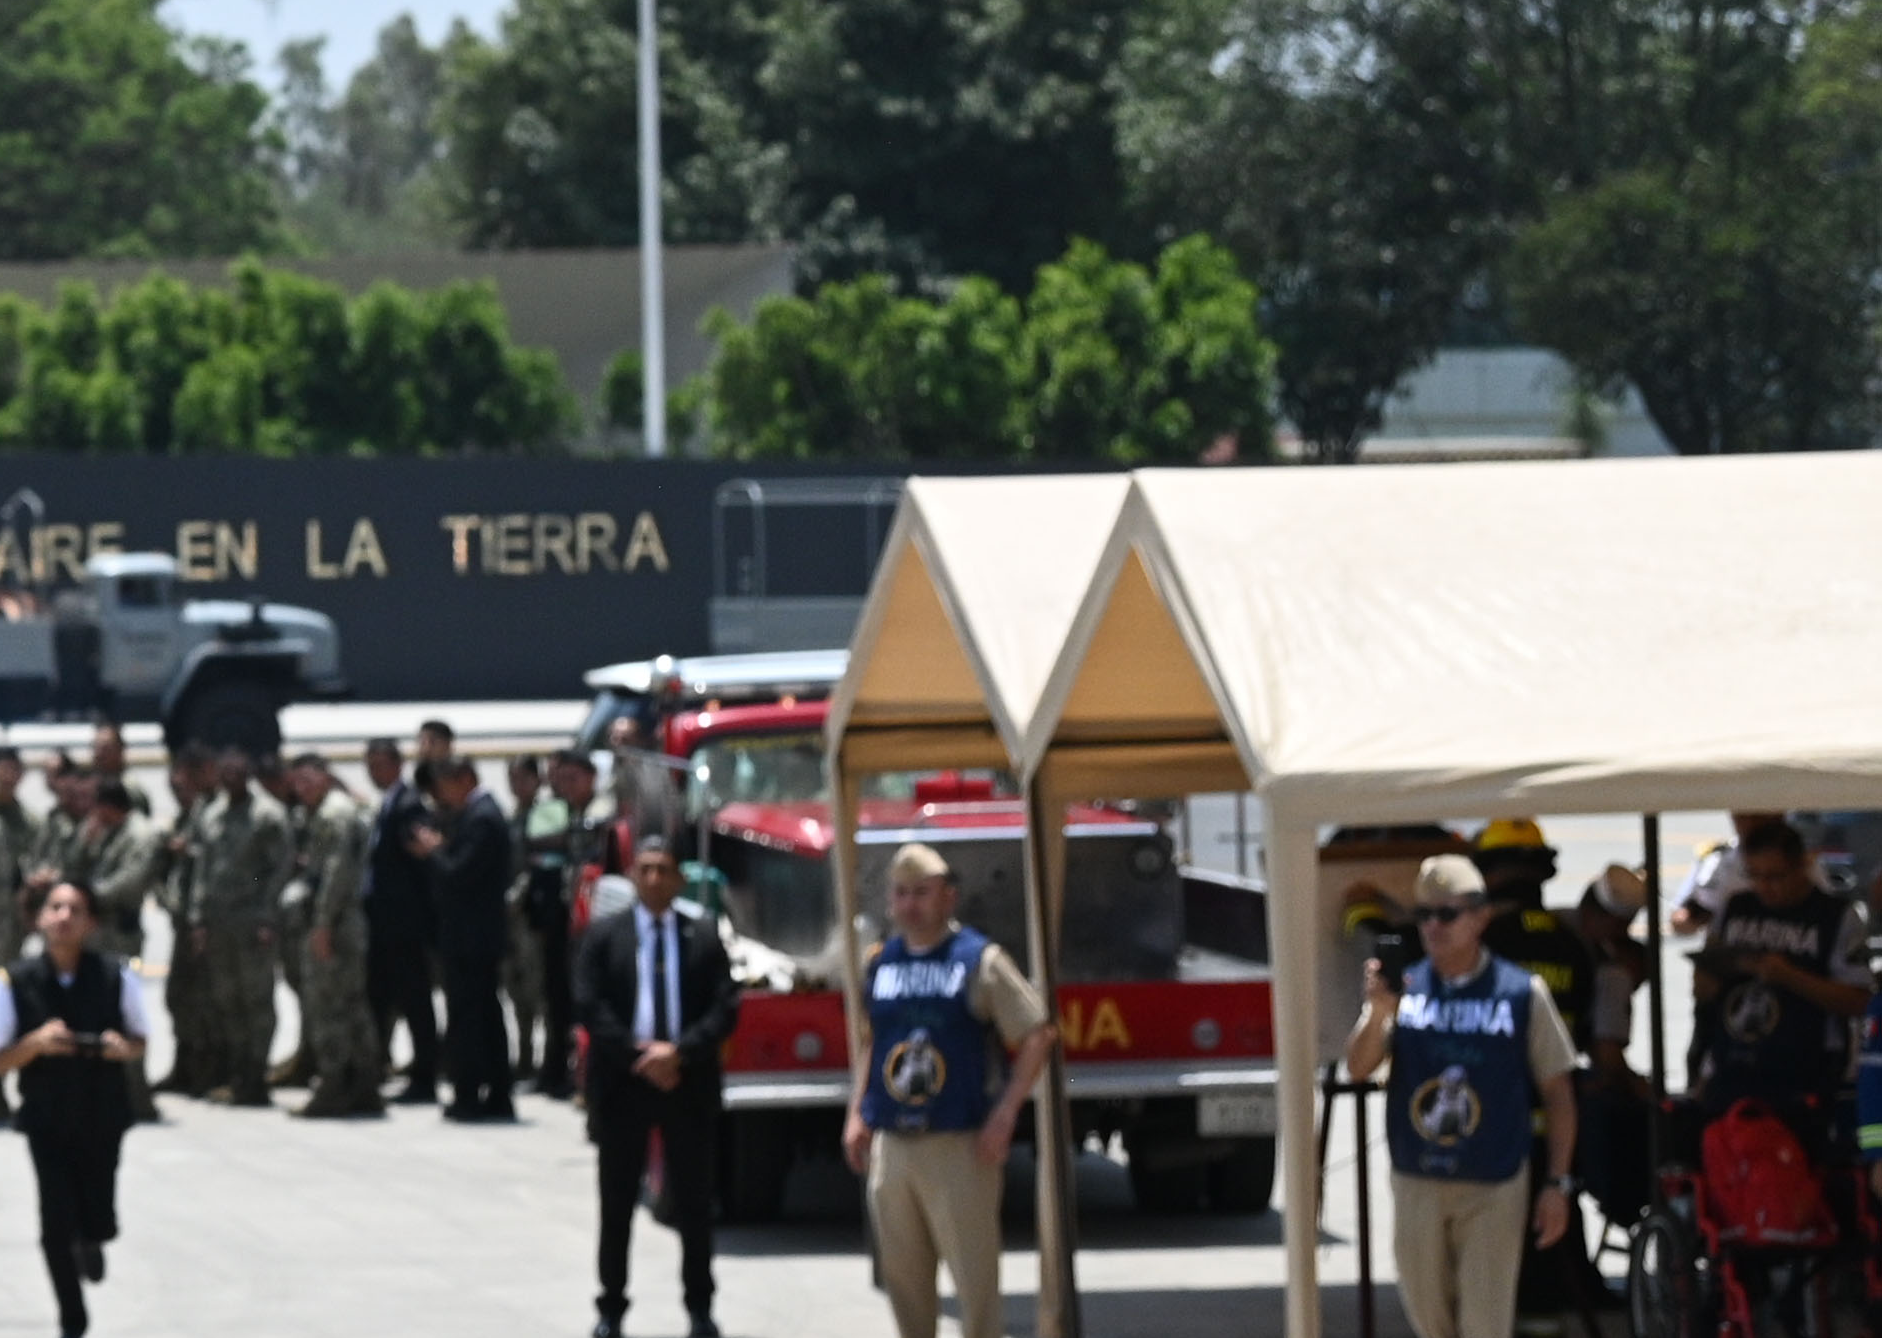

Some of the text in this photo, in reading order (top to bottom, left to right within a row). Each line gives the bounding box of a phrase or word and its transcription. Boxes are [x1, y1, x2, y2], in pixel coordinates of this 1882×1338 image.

[175, 519, 259, 583] EN
[305, 517, 388, 579] LA
[439, 511, 670, 576] TIERRA
